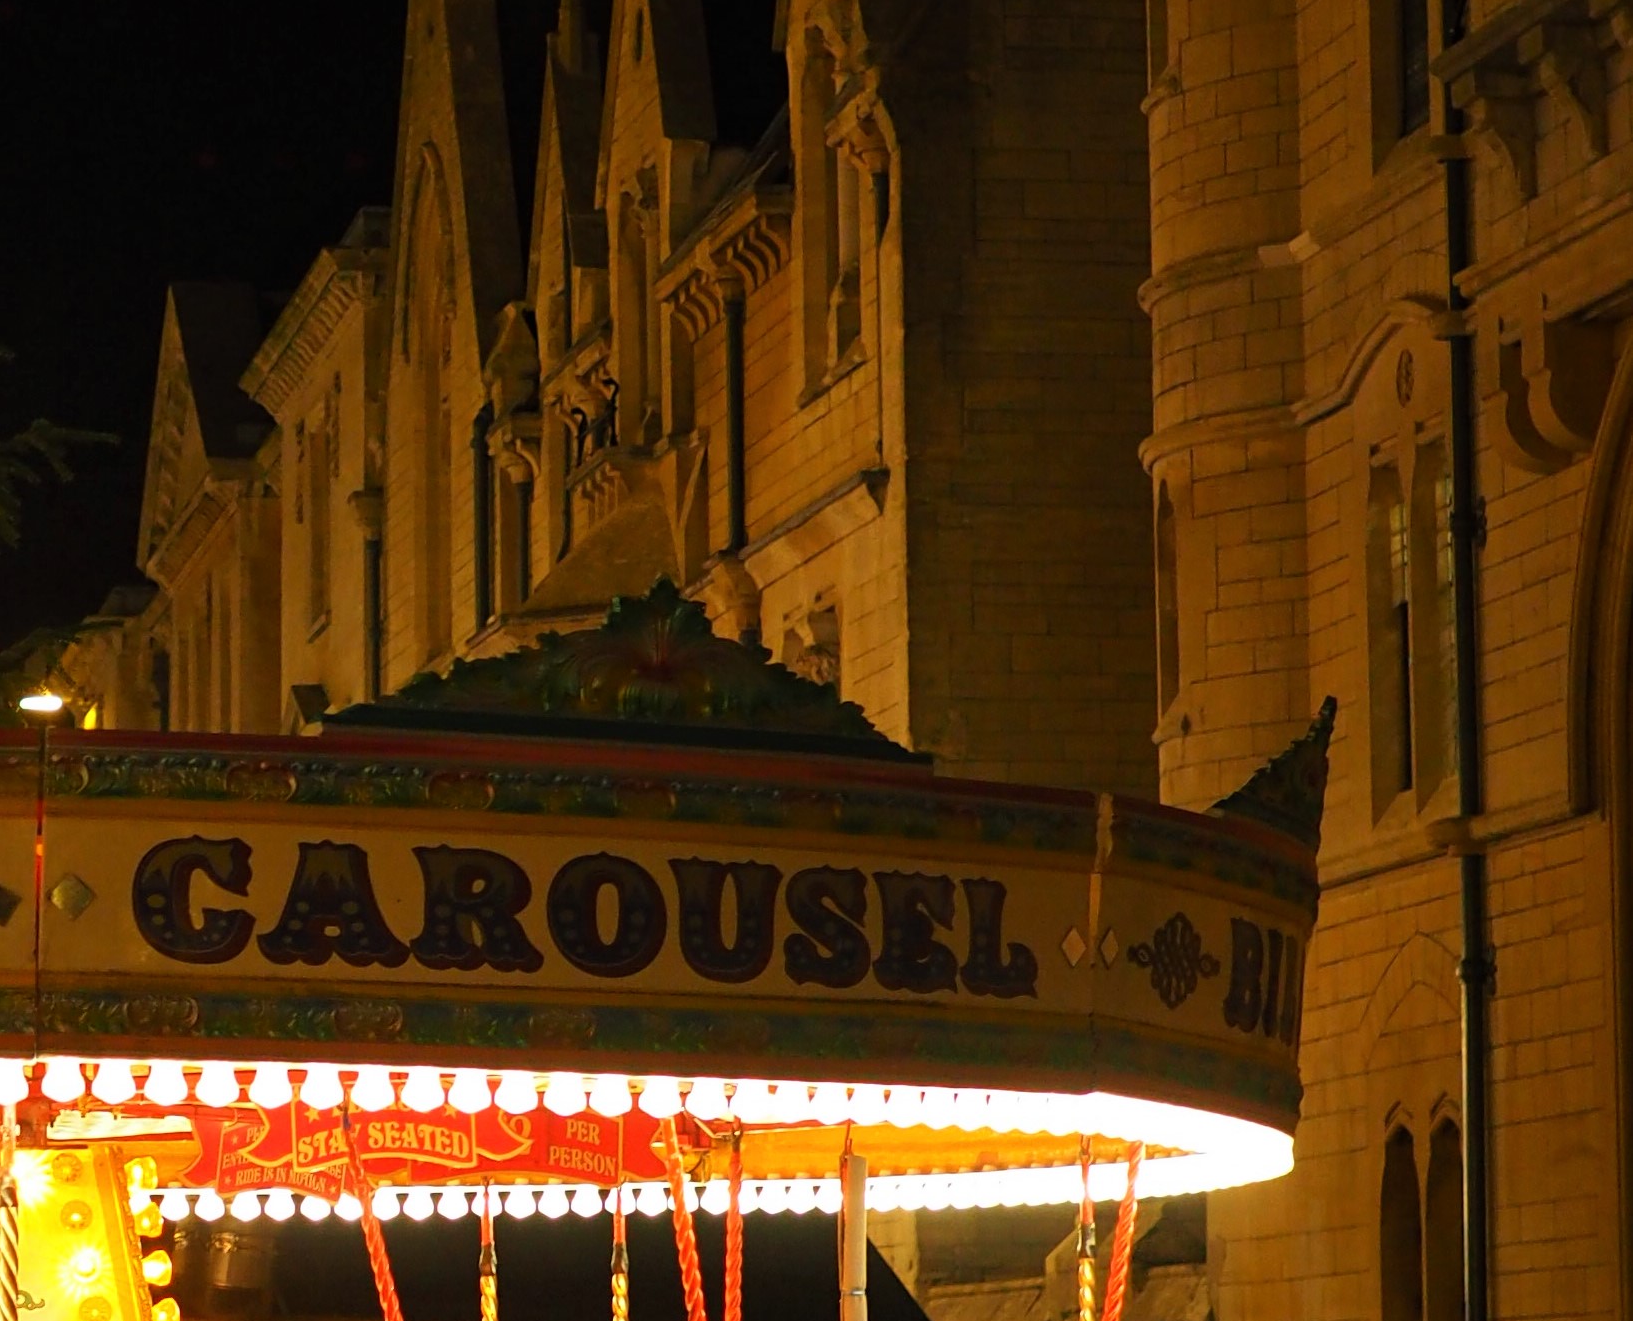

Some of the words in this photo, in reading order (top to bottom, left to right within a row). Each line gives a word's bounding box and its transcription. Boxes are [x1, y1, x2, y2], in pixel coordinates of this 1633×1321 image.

[132, 834, 1039, 998] CAROUSEL
[367, 1121, 470, 1159] SEATED
[566, 1118, 600, 1146] PER
[235, 1168, 261, 1186] RIDE
[264, 1168, 275, 1182] IS
[276, 1168, 287, 1182] IN
[549, 1145, 617, 1177] PERSON
